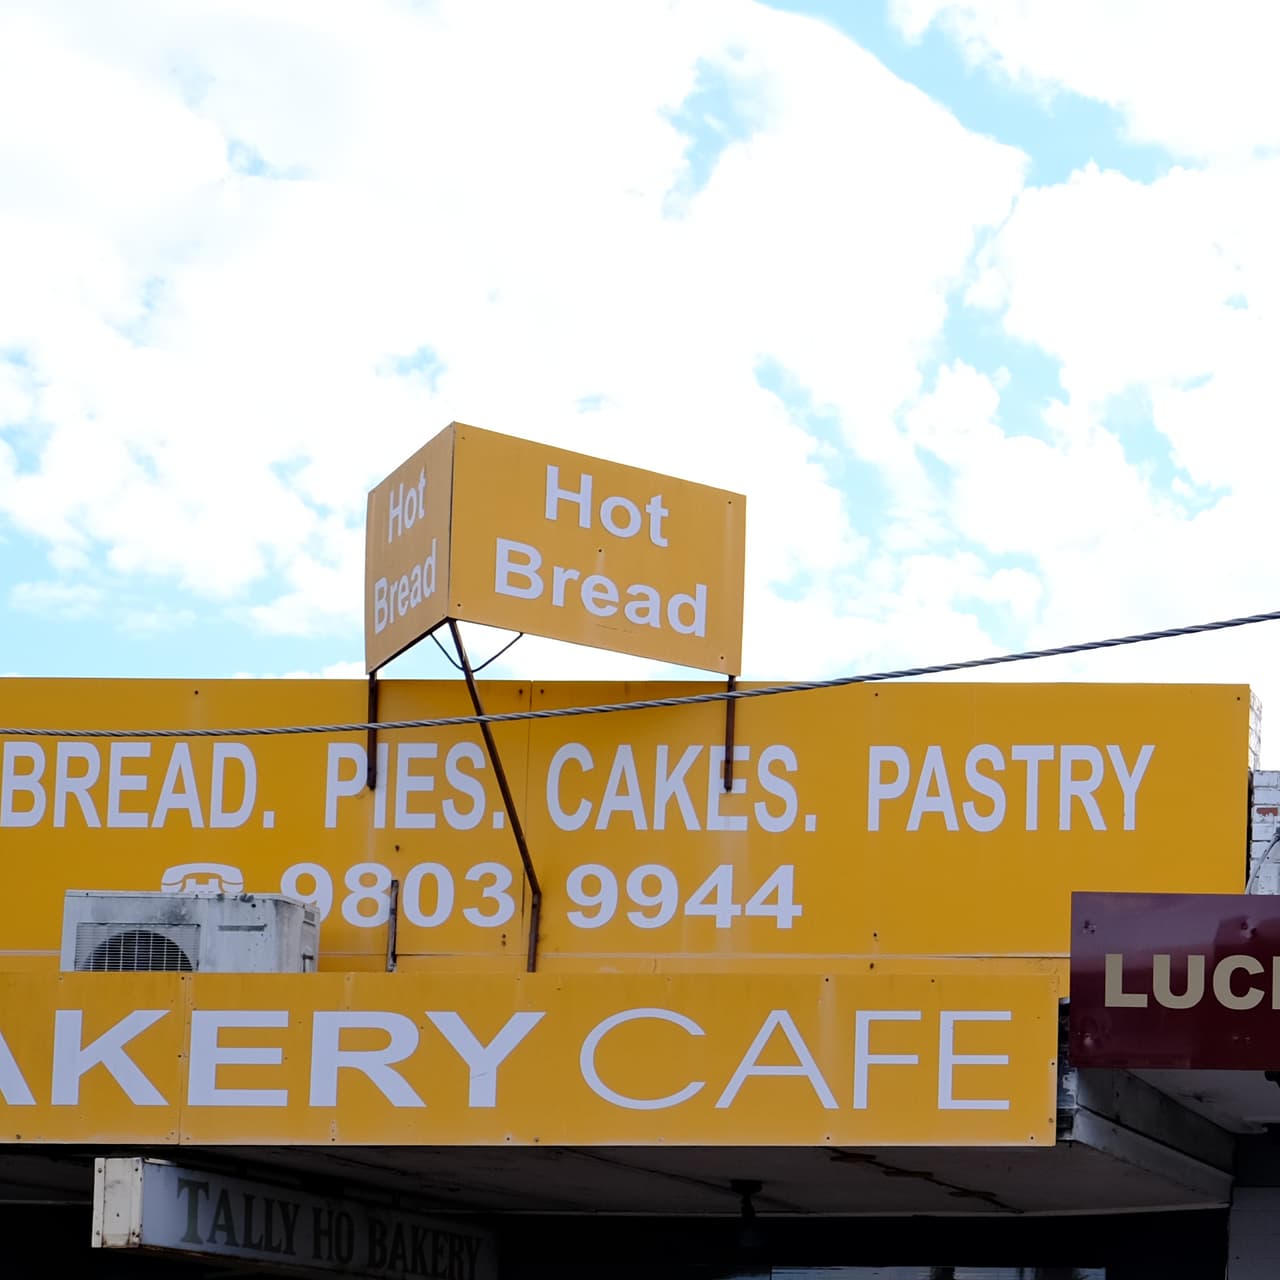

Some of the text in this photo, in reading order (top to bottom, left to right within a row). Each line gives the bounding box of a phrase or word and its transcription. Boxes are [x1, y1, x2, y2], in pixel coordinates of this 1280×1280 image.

[387, 467, 427, 544] Hot
[545, 464, 670, 548] Hot
[374, 539, 437, 633] Bread
[494, 537, 708, 639] Bread
[0, 741, 1155, 832] BREAD. PIES. CAKES. PASTRY
[280, 861, 802, 928] 9803 9944
[580, 1009, 1011, 1111] CAFE
[177, 1177, 300, 1255] TALLY
[312, 1208, 354, 1265] HO
